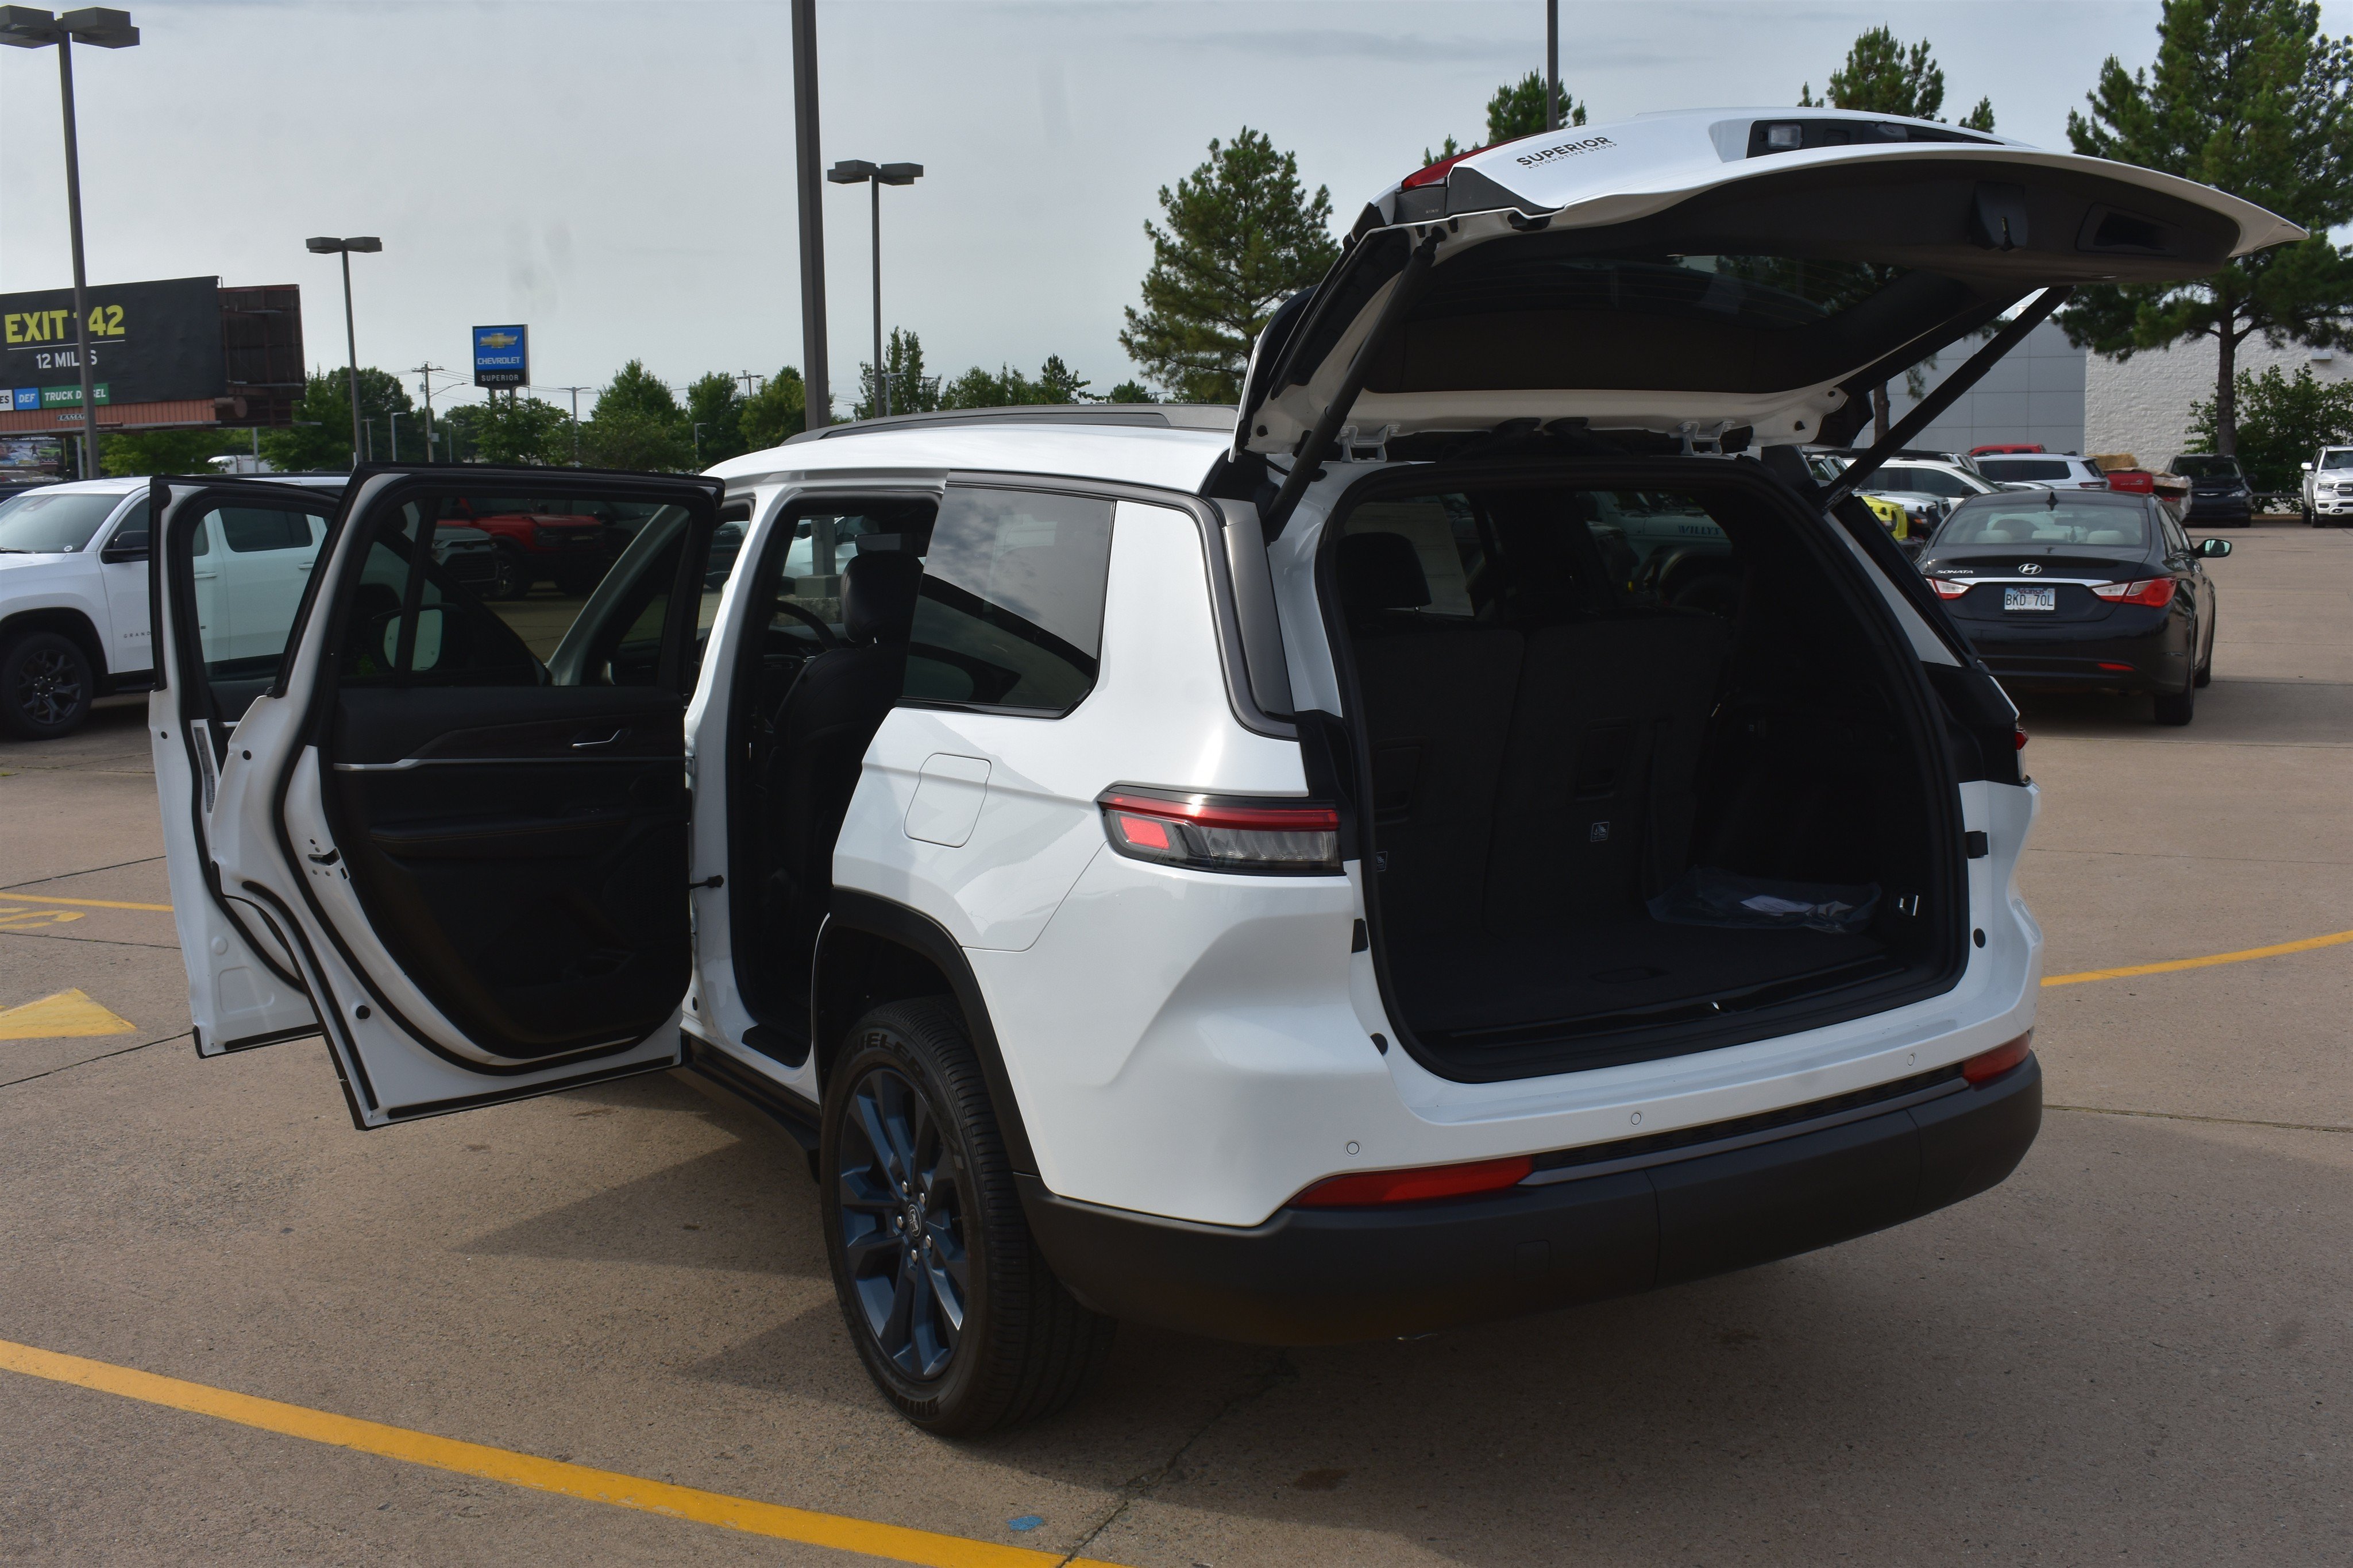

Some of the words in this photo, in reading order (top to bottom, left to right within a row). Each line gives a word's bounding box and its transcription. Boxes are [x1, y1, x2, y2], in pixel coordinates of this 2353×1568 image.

[1516, 137, 1614, 165] SUPERIOR
[1528, 150, 1584, 169] AUTOMOTIVE
[1589, 143, 1618, 152] GROUP
[5, 309, 68, 343] EXIT
[73, 304, 125, 336] 42
[36, 353, 51, 369] 12
[55, 349, 97, 368] MILS
[477, 356, 520, 365] CHEVROLET
[18, 393, 36, 403] DEF
[45, 391, 74, 401] TRUCK
[1678, 525, 1720, 535] WILLYS
[2005, 594, 2026, 606] BKD
[2034, 594, 2054, 607] 70L
